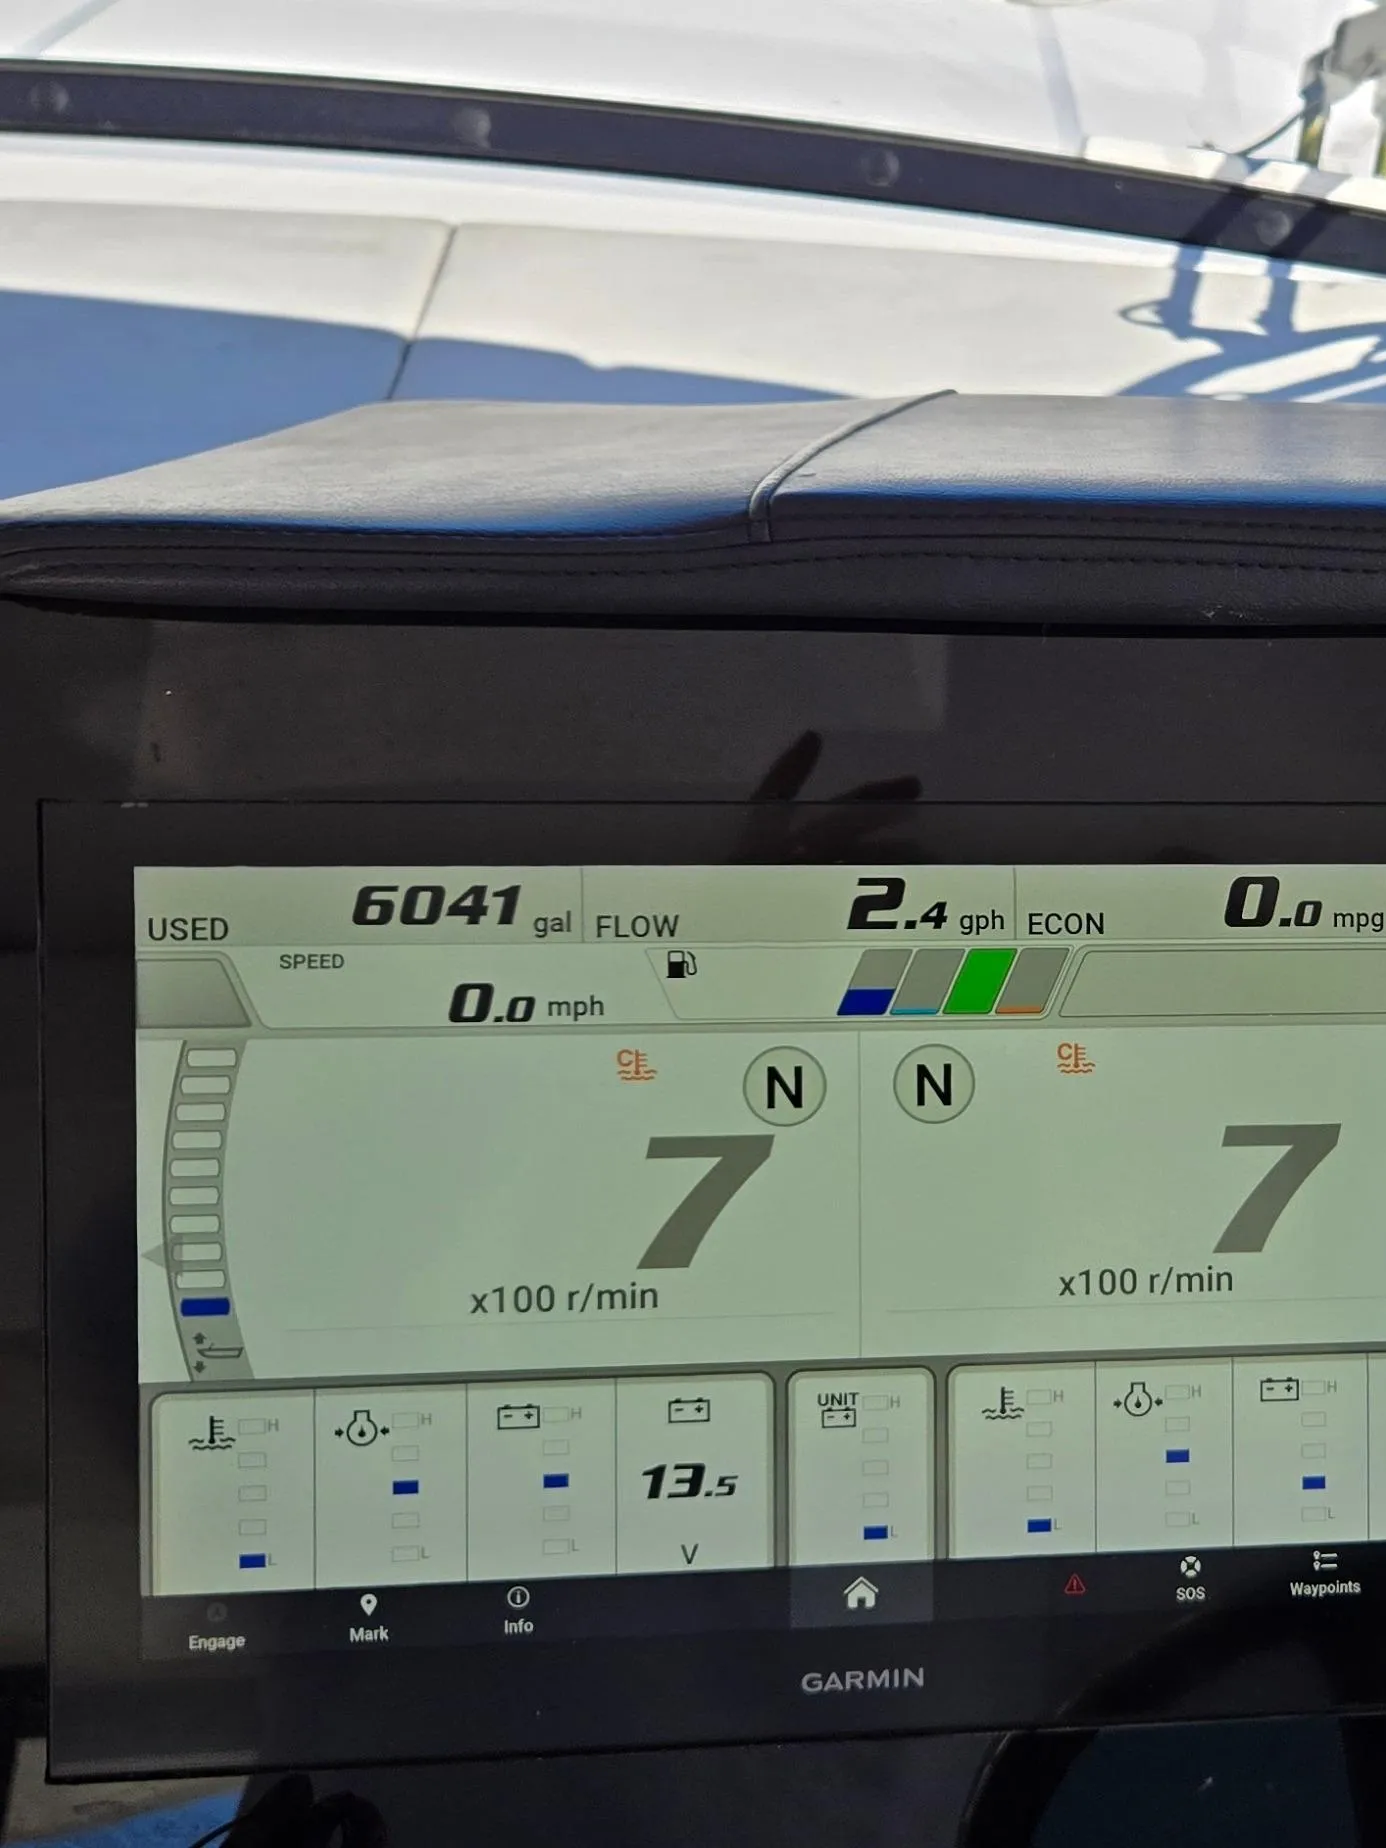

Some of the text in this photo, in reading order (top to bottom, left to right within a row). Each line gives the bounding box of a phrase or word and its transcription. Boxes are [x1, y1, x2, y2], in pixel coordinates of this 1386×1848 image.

[352, 884, 572, 938] 6041 gal
[846, 877, 1005, 935] 2.4 gph
[1223, 876, 1385, 933] 0.0 mpg
[148, 917, 229, 942] USED
[595, 914, 680, 939] FLOW
[1028, 912, 1105, 936] ECON
[279, 953, 345, 970] SPEED
[447, 982, 605, 1023] 0.0 mph
[766, 1065, 803, 1109] N
[916, 1063, 952, 1107] N
[1212, 1123, 1342, 1254] 7
[637, 1133, 776, 1270] 7
[1058, 1265, 1234, 1297] x100 r/min
[469, 1281, 660, 1315] x100 r/min
[1053, 1390, 1064, 1403] H
[1191, 1385, 1201, 1398] H
[1327, 1381, 1337, 1394] H
[817, 1392, 860, 1407] UNIT
[890, 1396, 900, 1409] H
[421, 1413, 432, 1426] H
[571, 1407, 582, 1420] H
[267, 1418, 279, 1433] H
[641, 1463, 739, 1500] 13.5
[680, 1544, 699, 1565] V
[1176, 1586, 1206, 1601] SOS
[1290, 1579, 1361, 1598] Waypoints
[349, 1626, 389, 1643] Mark
[504, 1619, 534, 1635] Info
[188, 1633, 246, 1654] Engage
[801, 1667, 925, 1695] GARMIN
